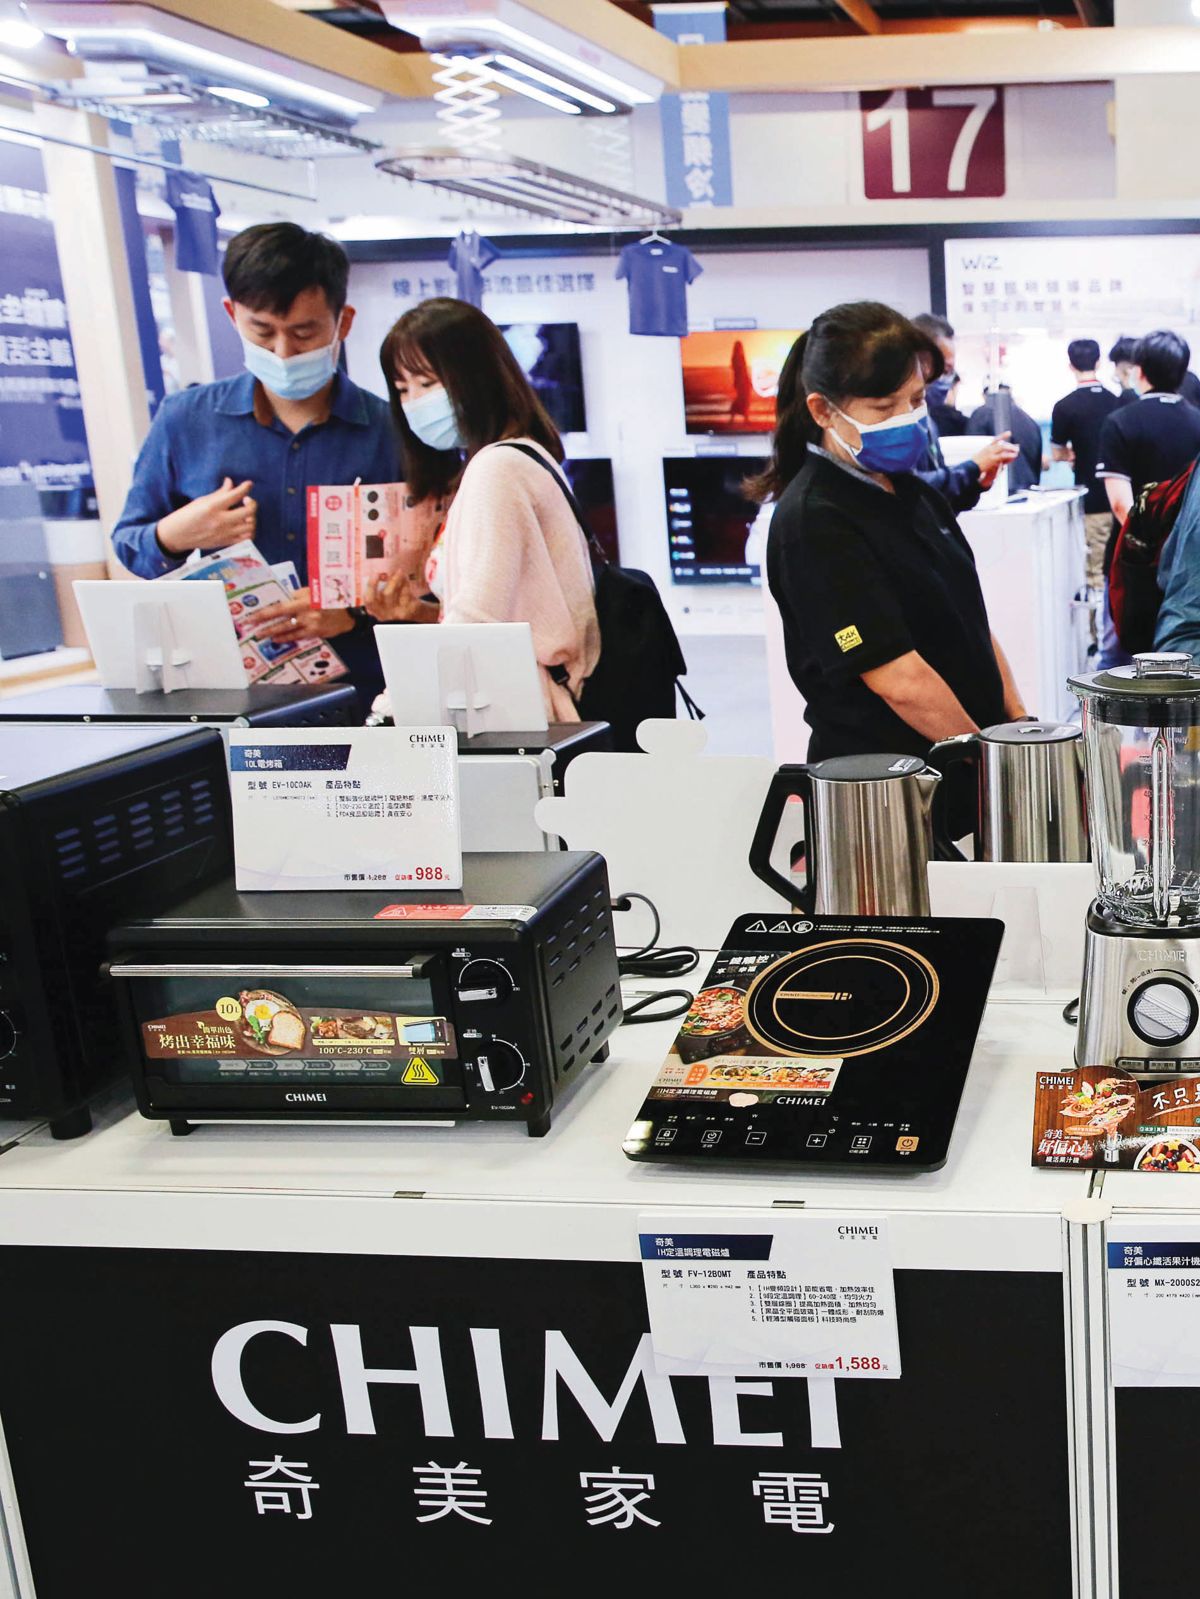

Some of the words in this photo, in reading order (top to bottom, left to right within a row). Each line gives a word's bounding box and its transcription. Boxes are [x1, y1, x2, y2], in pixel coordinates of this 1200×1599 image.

[867, 88, 998, 193] 17
[415, 866, 443, 881] 988
[159, 1034, 237, 1049] 烤出幸福味
[1039, 1076, 1075, 1086] CHIMEI
[285, 1092, 327, 1102] CHIMEI
[776, 1096, 827, 1106] CHIMEI
[837, 1225, 879, 1235] CHIMEI
[655, 1237, 675, 1247] 奇美
[1123, 1246, 1144, 1256] 奇美
[746, 1270, 787, 1279] 產品特點
[1154, 1278, 1200, 1287] MX-2000S2
[758, 1361, 782, 1369] 市售價
[835, 1355, 881, 1372] 1,588
[210, 1319, 843, 1449] CHIMEI
[244, 1453, 836, 1534] 奇美家電
